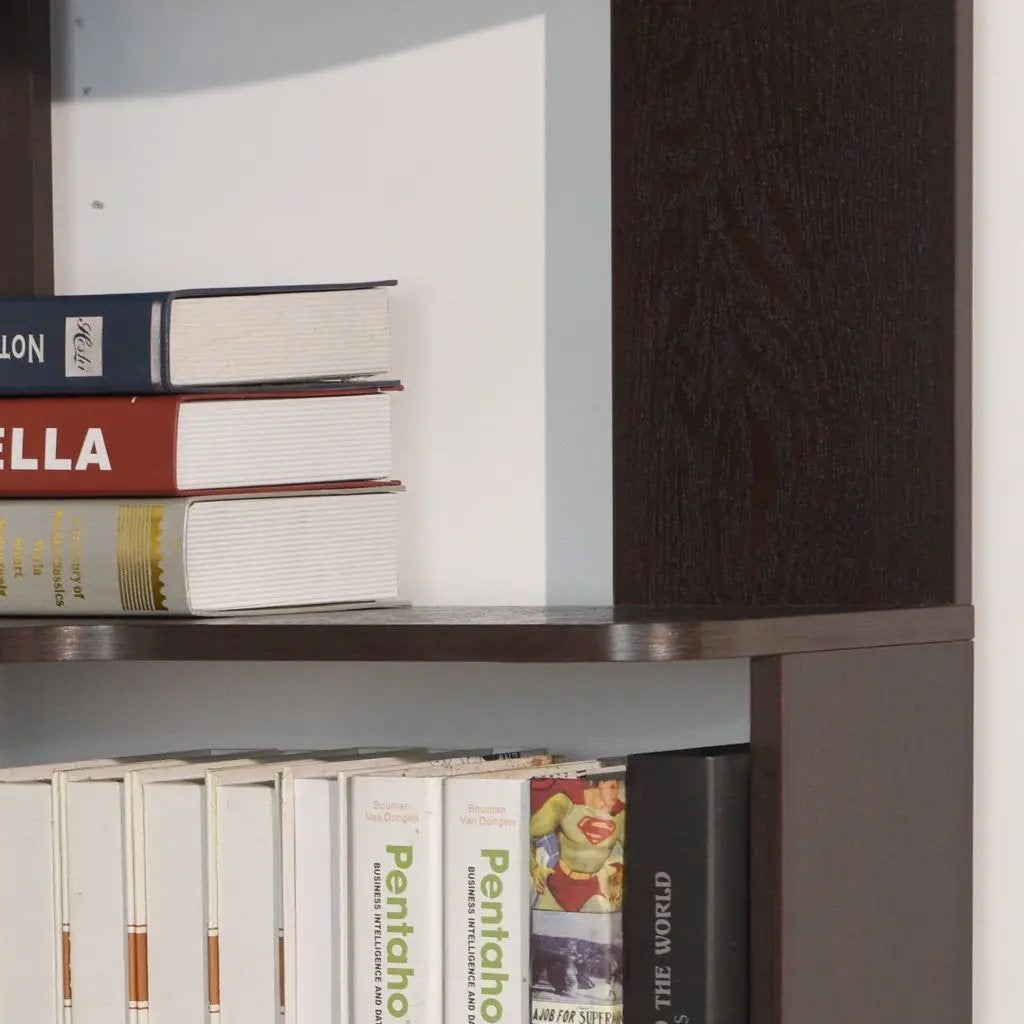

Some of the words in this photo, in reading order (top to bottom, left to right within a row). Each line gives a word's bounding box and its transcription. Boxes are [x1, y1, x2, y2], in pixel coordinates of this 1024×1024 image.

[478, 816, 516, 829] Dongen
[373, 862, 381, 910] BUSINESS
[467, 866, 475, 914] BUSINESS
[386, 845, 415, 1018] Pentaho
[480, 849, 510, 1024] Pentaho
[654, 871, 672, 955] WORLD
[374, 914, 382, 982] INTELLIGENCE
[467, 918, 476, 987] INTELLIGENCE
[374, 985, 382, 1006] AND
[467, 991, 475, 1011] AND
[654, 965, 672, 1010] THE
[557, 1010, 576, 1023] FOR
